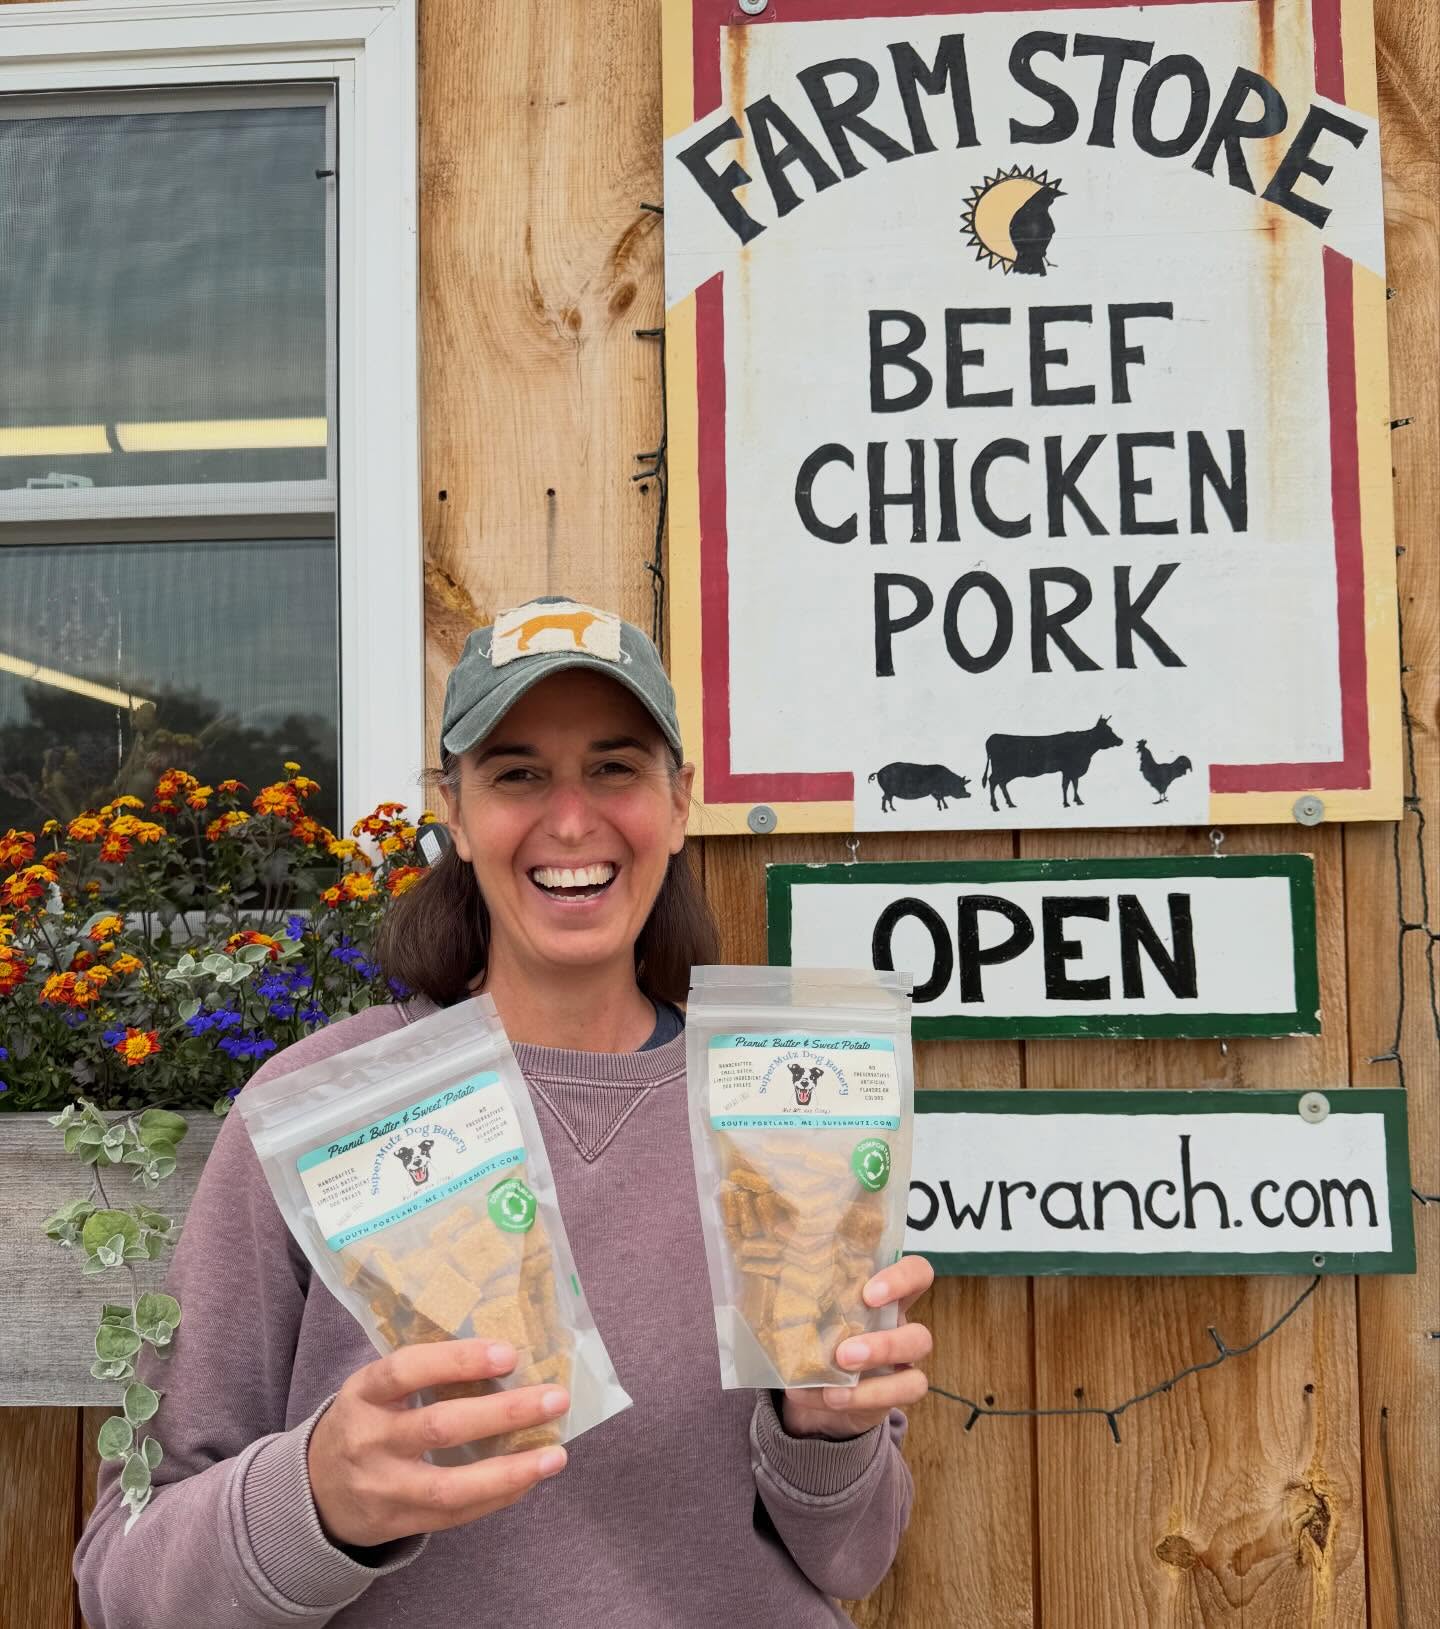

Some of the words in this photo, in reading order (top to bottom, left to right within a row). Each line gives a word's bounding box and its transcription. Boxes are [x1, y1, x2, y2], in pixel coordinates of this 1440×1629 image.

[676, 33, 981, 245] FARM
[1009, 30, 1368, 229] STORE
[868, 302, 1174, 413] BEEF
[795, 429, 1248, 544] CHICKEN
[874, 562, 1187, 677] PORK
[872, 893, 1197, 1003] OPEN
[735, 1036, 768, 1048] Peanut
[772, 1038, 801, 1048] Butter
[811, 1039, 840, 1050] Sweet
[841, 1040, 871, 1050] Potato
[802, 1050, 824, 1066] Dog
[825, 1059, 849, 1096] Bakery
[327, 1134, 365, 1159] Peanut
[369, 1120, 400, 1141] Butter
[402, 1111, 410, 1125] &
[412, 1098, 442, 1121] Sweet
[443, 1085, 475, 1106] Potato
[370, 1134, 401, 1196] SuperMutz
[404, 1124, 430, 1137] Dog
[432, 1124, 467, 1154] Bakery
[340, 1227, 369, 1244] SOUTH
[425, 1194, 438, 1204] ME
[448, 1155, 519, 1193] SUPERMUTZ.COM
[906, 1134, 1379, 1232] owranch.com
